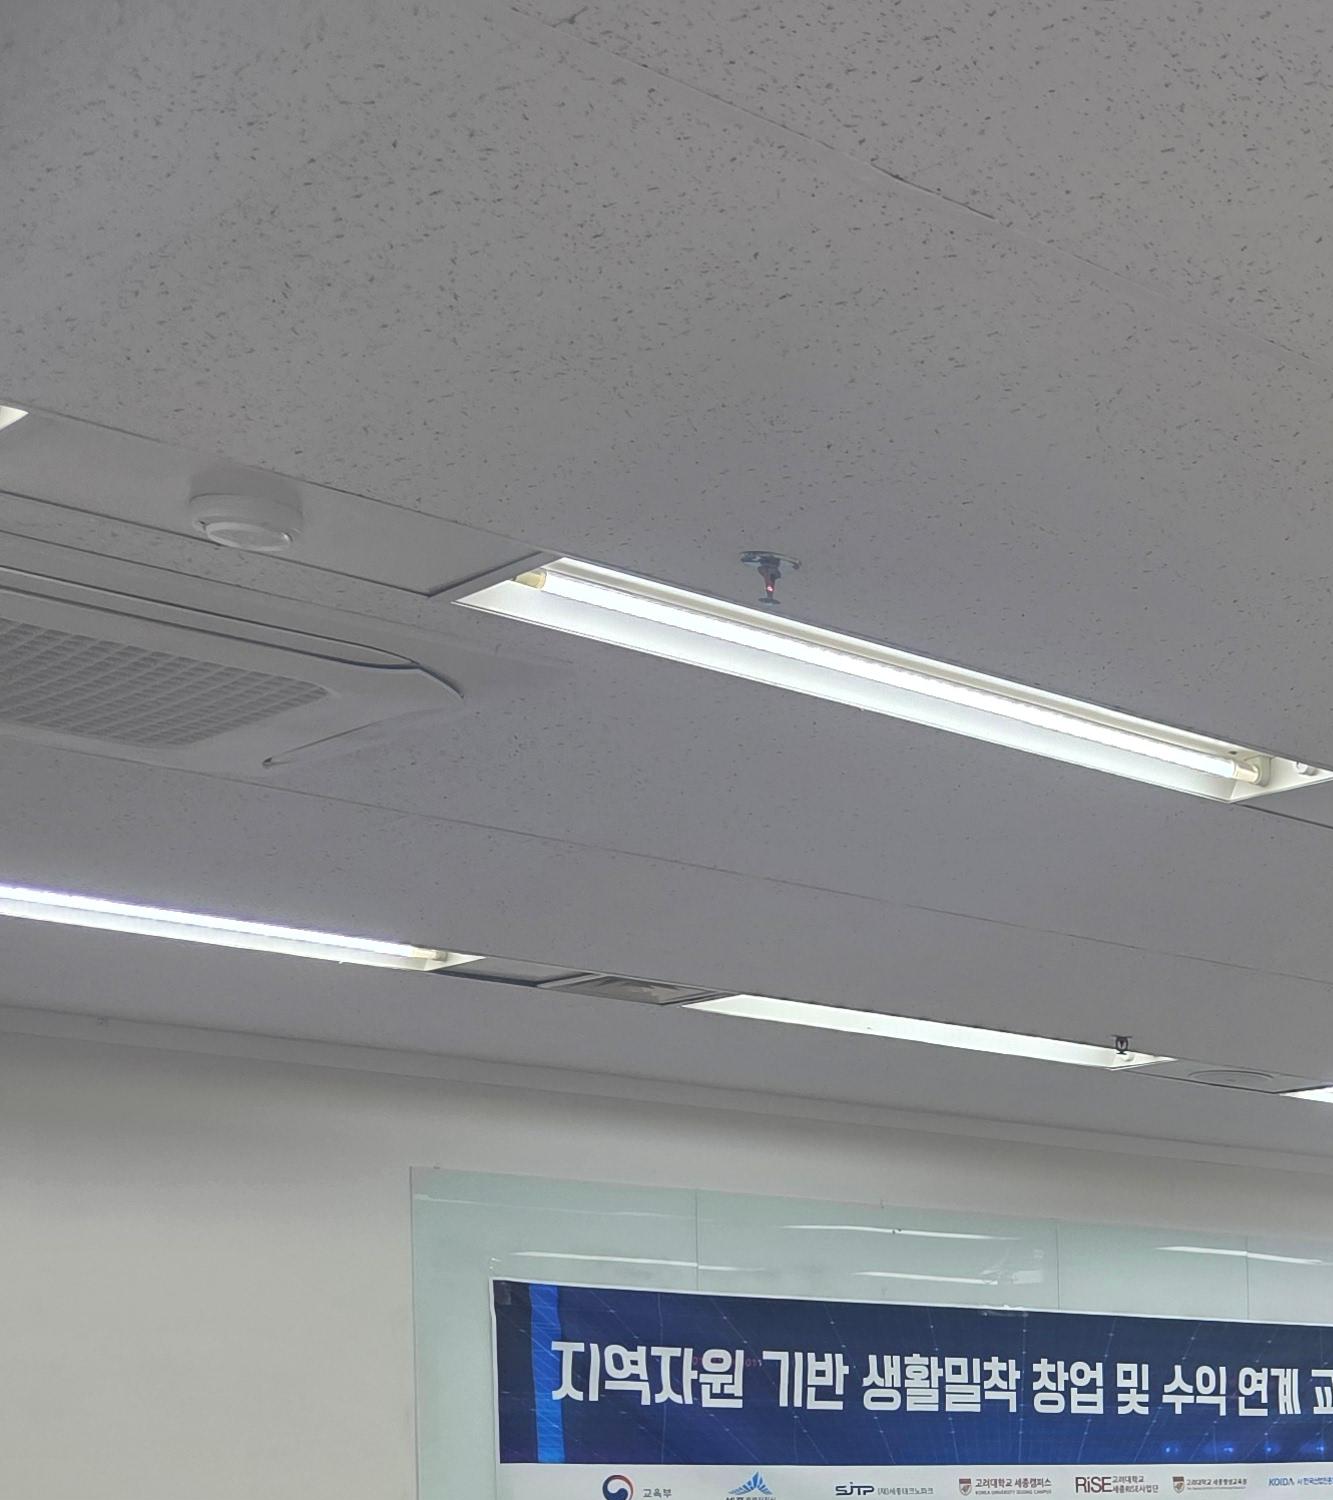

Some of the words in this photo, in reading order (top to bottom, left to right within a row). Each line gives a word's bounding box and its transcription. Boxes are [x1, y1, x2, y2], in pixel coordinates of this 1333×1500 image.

[551, 1341, 744, 1409] 지역자원
[762, 1350, 849, 1410] 기반
[862, 1353, 1021, 1413] 생활밀착
[1032, 1358, 1104, 1414] 창업
[1116, 1363, 1149, 1415] 및
[1162, 1364, 1227, 1416] 수익
[1238, 1367, 1302, 1416] 연계
[975, 1478, 1013, 1489] 고려대학교
[1014, 1478, 1052, 1488] 세종캠퍼스
[643, 1488, 672, 1498] 교육부
